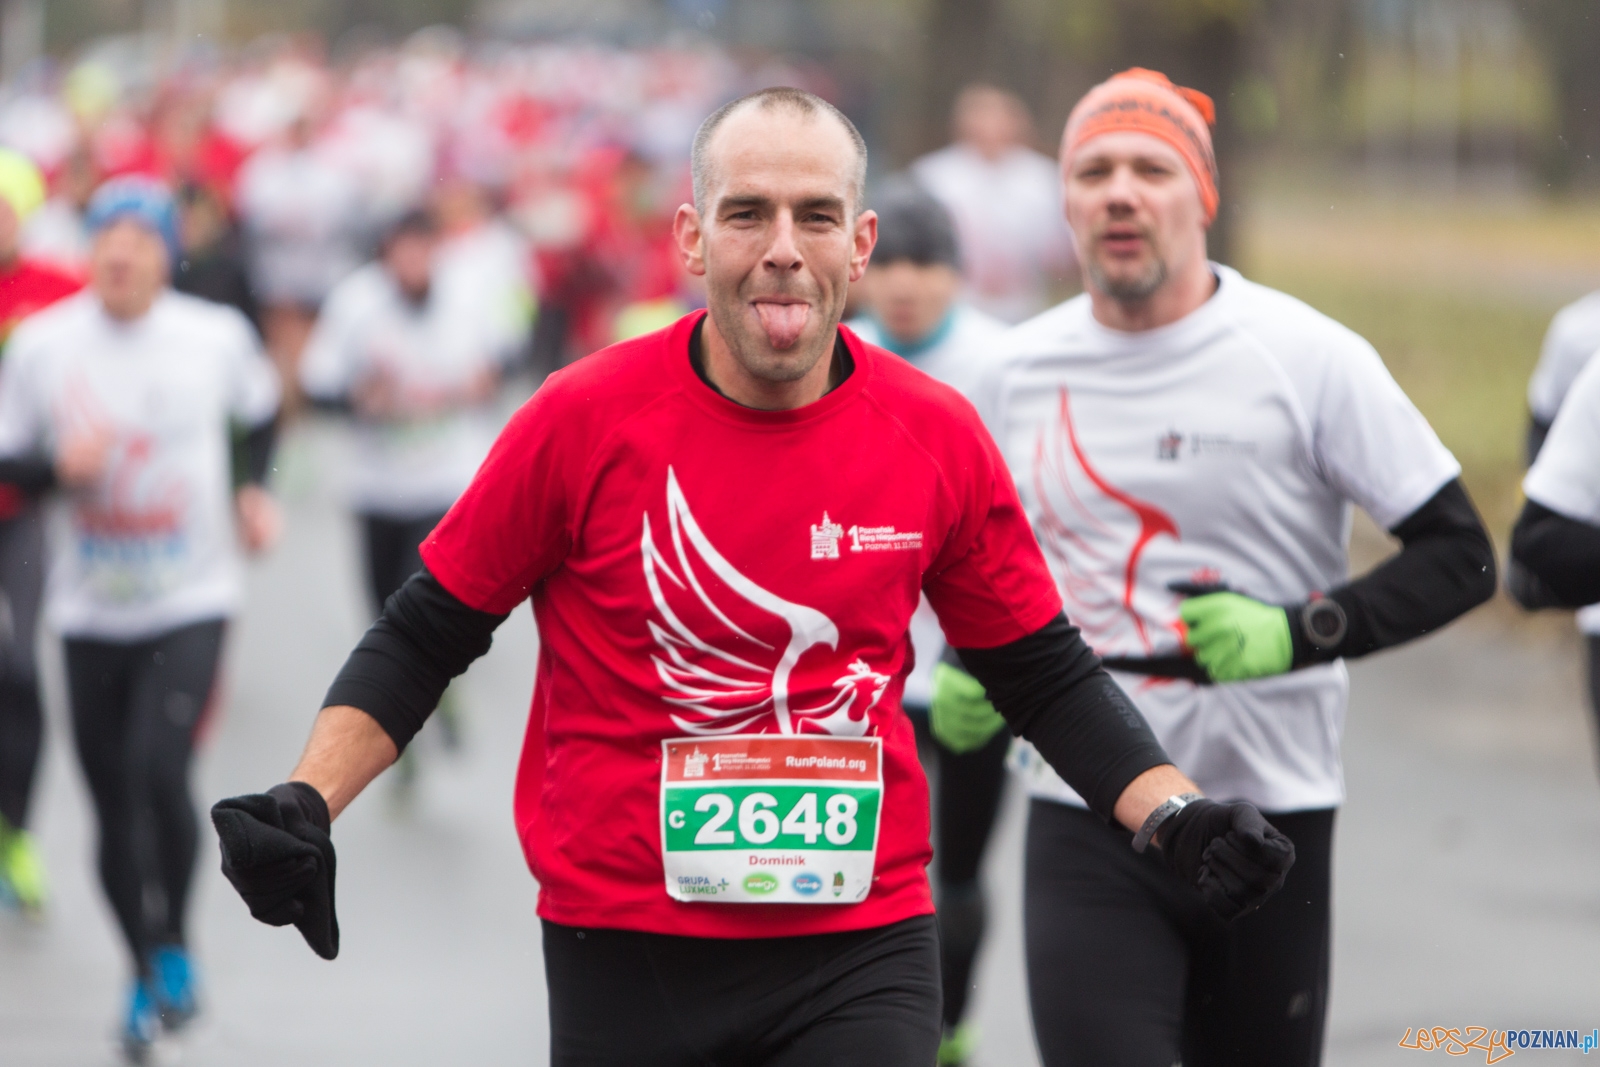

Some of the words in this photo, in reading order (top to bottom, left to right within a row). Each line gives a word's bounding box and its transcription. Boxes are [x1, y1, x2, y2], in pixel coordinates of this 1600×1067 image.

[847, 525, 863, 551] 1
[785, 755, 866, 772] RunPoland.org
[694, 792, 859, 845] 2648
[749, 855, 806, 866] Dominik
[677, 876, 711, 886] GRUPA
[679, 885, 718, 895] LUXMED
